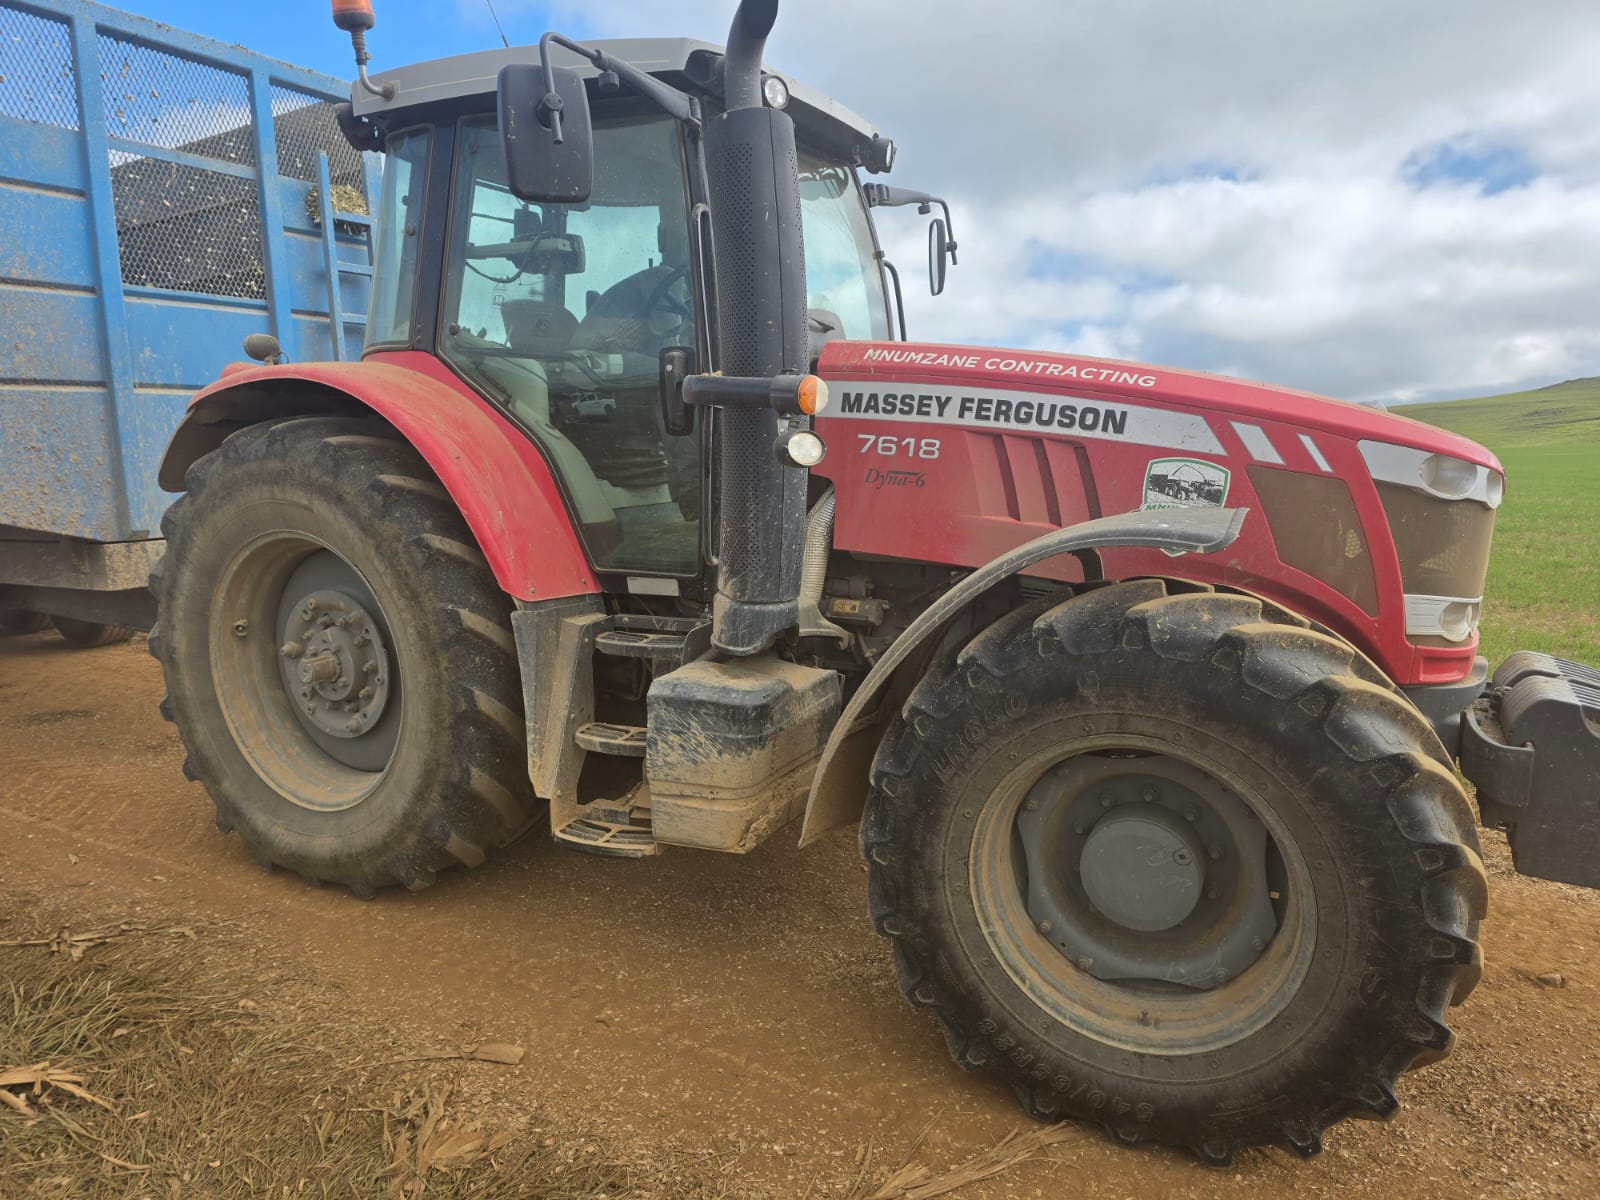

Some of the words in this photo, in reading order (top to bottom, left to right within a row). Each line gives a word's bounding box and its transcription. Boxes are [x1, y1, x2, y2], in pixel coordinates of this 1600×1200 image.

[863, 347, 980, 369] MNUMZANE
[984, 358, 1157, 387] CONTRACTING
[840, 392, 952, 418] MASSEY
[957, 397, 1128, 434] FERGUSON
[857, 434, 941, 460] 7618
[864, 468, 926, 490] Dyna-6
